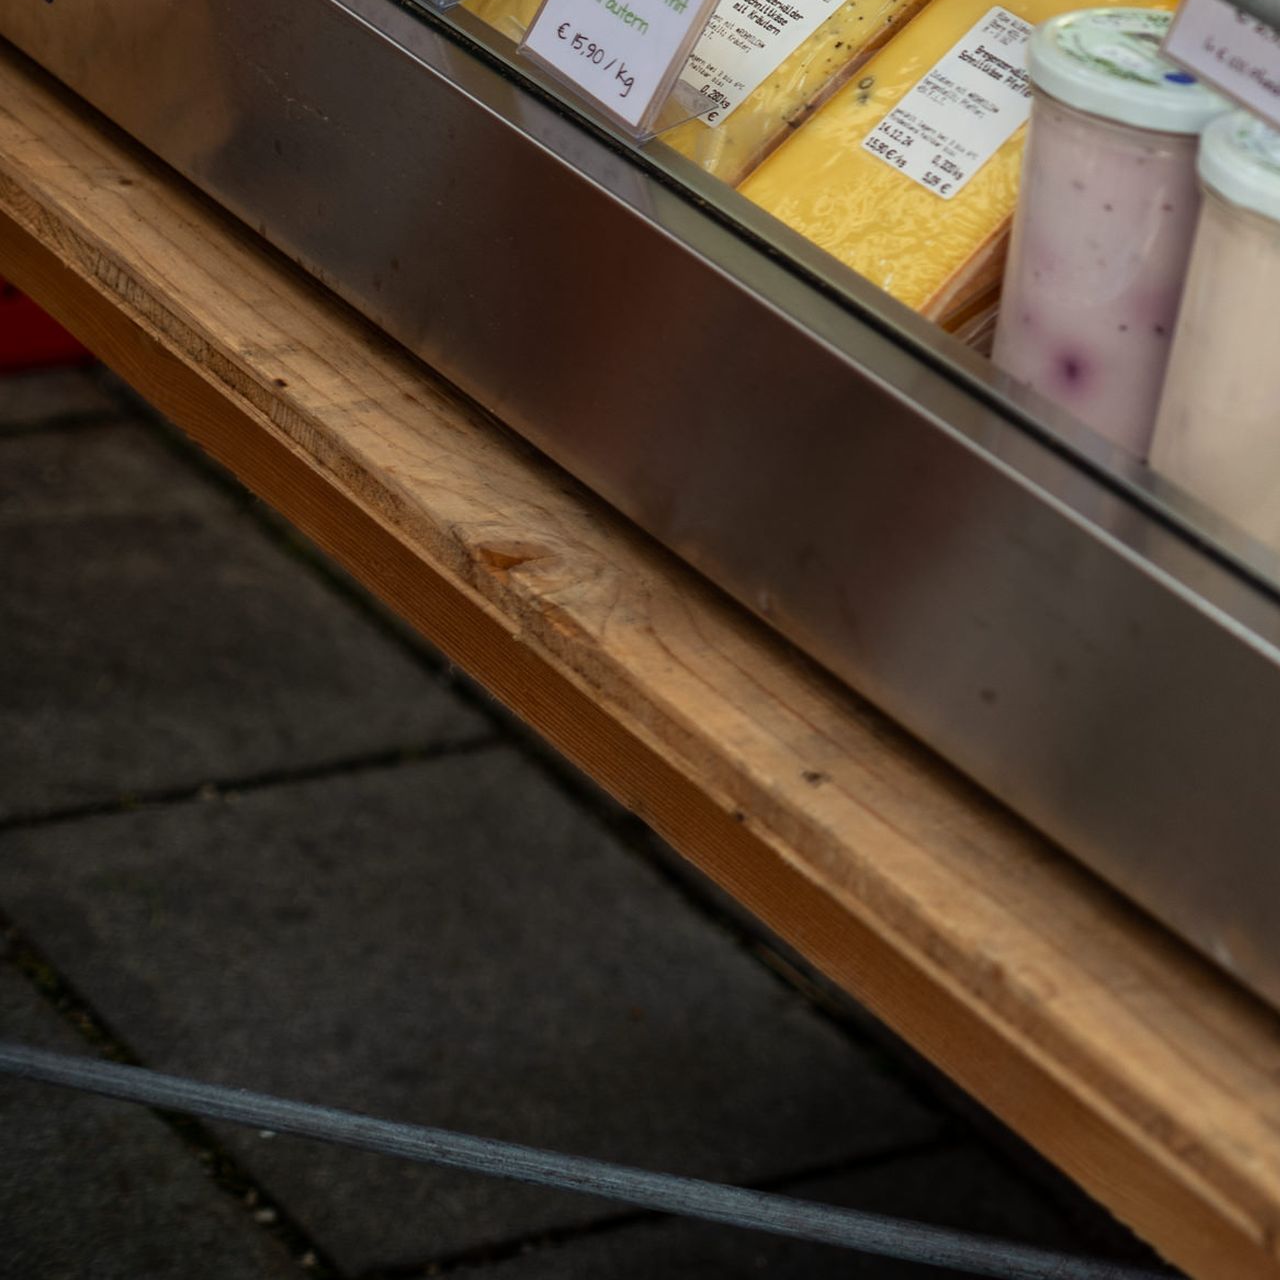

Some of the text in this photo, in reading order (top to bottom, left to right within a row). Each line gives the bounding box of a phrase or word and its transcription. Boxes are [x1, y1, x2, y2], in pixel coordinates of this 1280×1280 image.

[732, 2, 748, 14] mit
[746, 9, 780, 35] Kräutern
[557, 22, 570, 40] €
[570, 31, 606, 65] 15,90
[615, 62, 635, 98] kg
[707, 111, 719, 122] €
